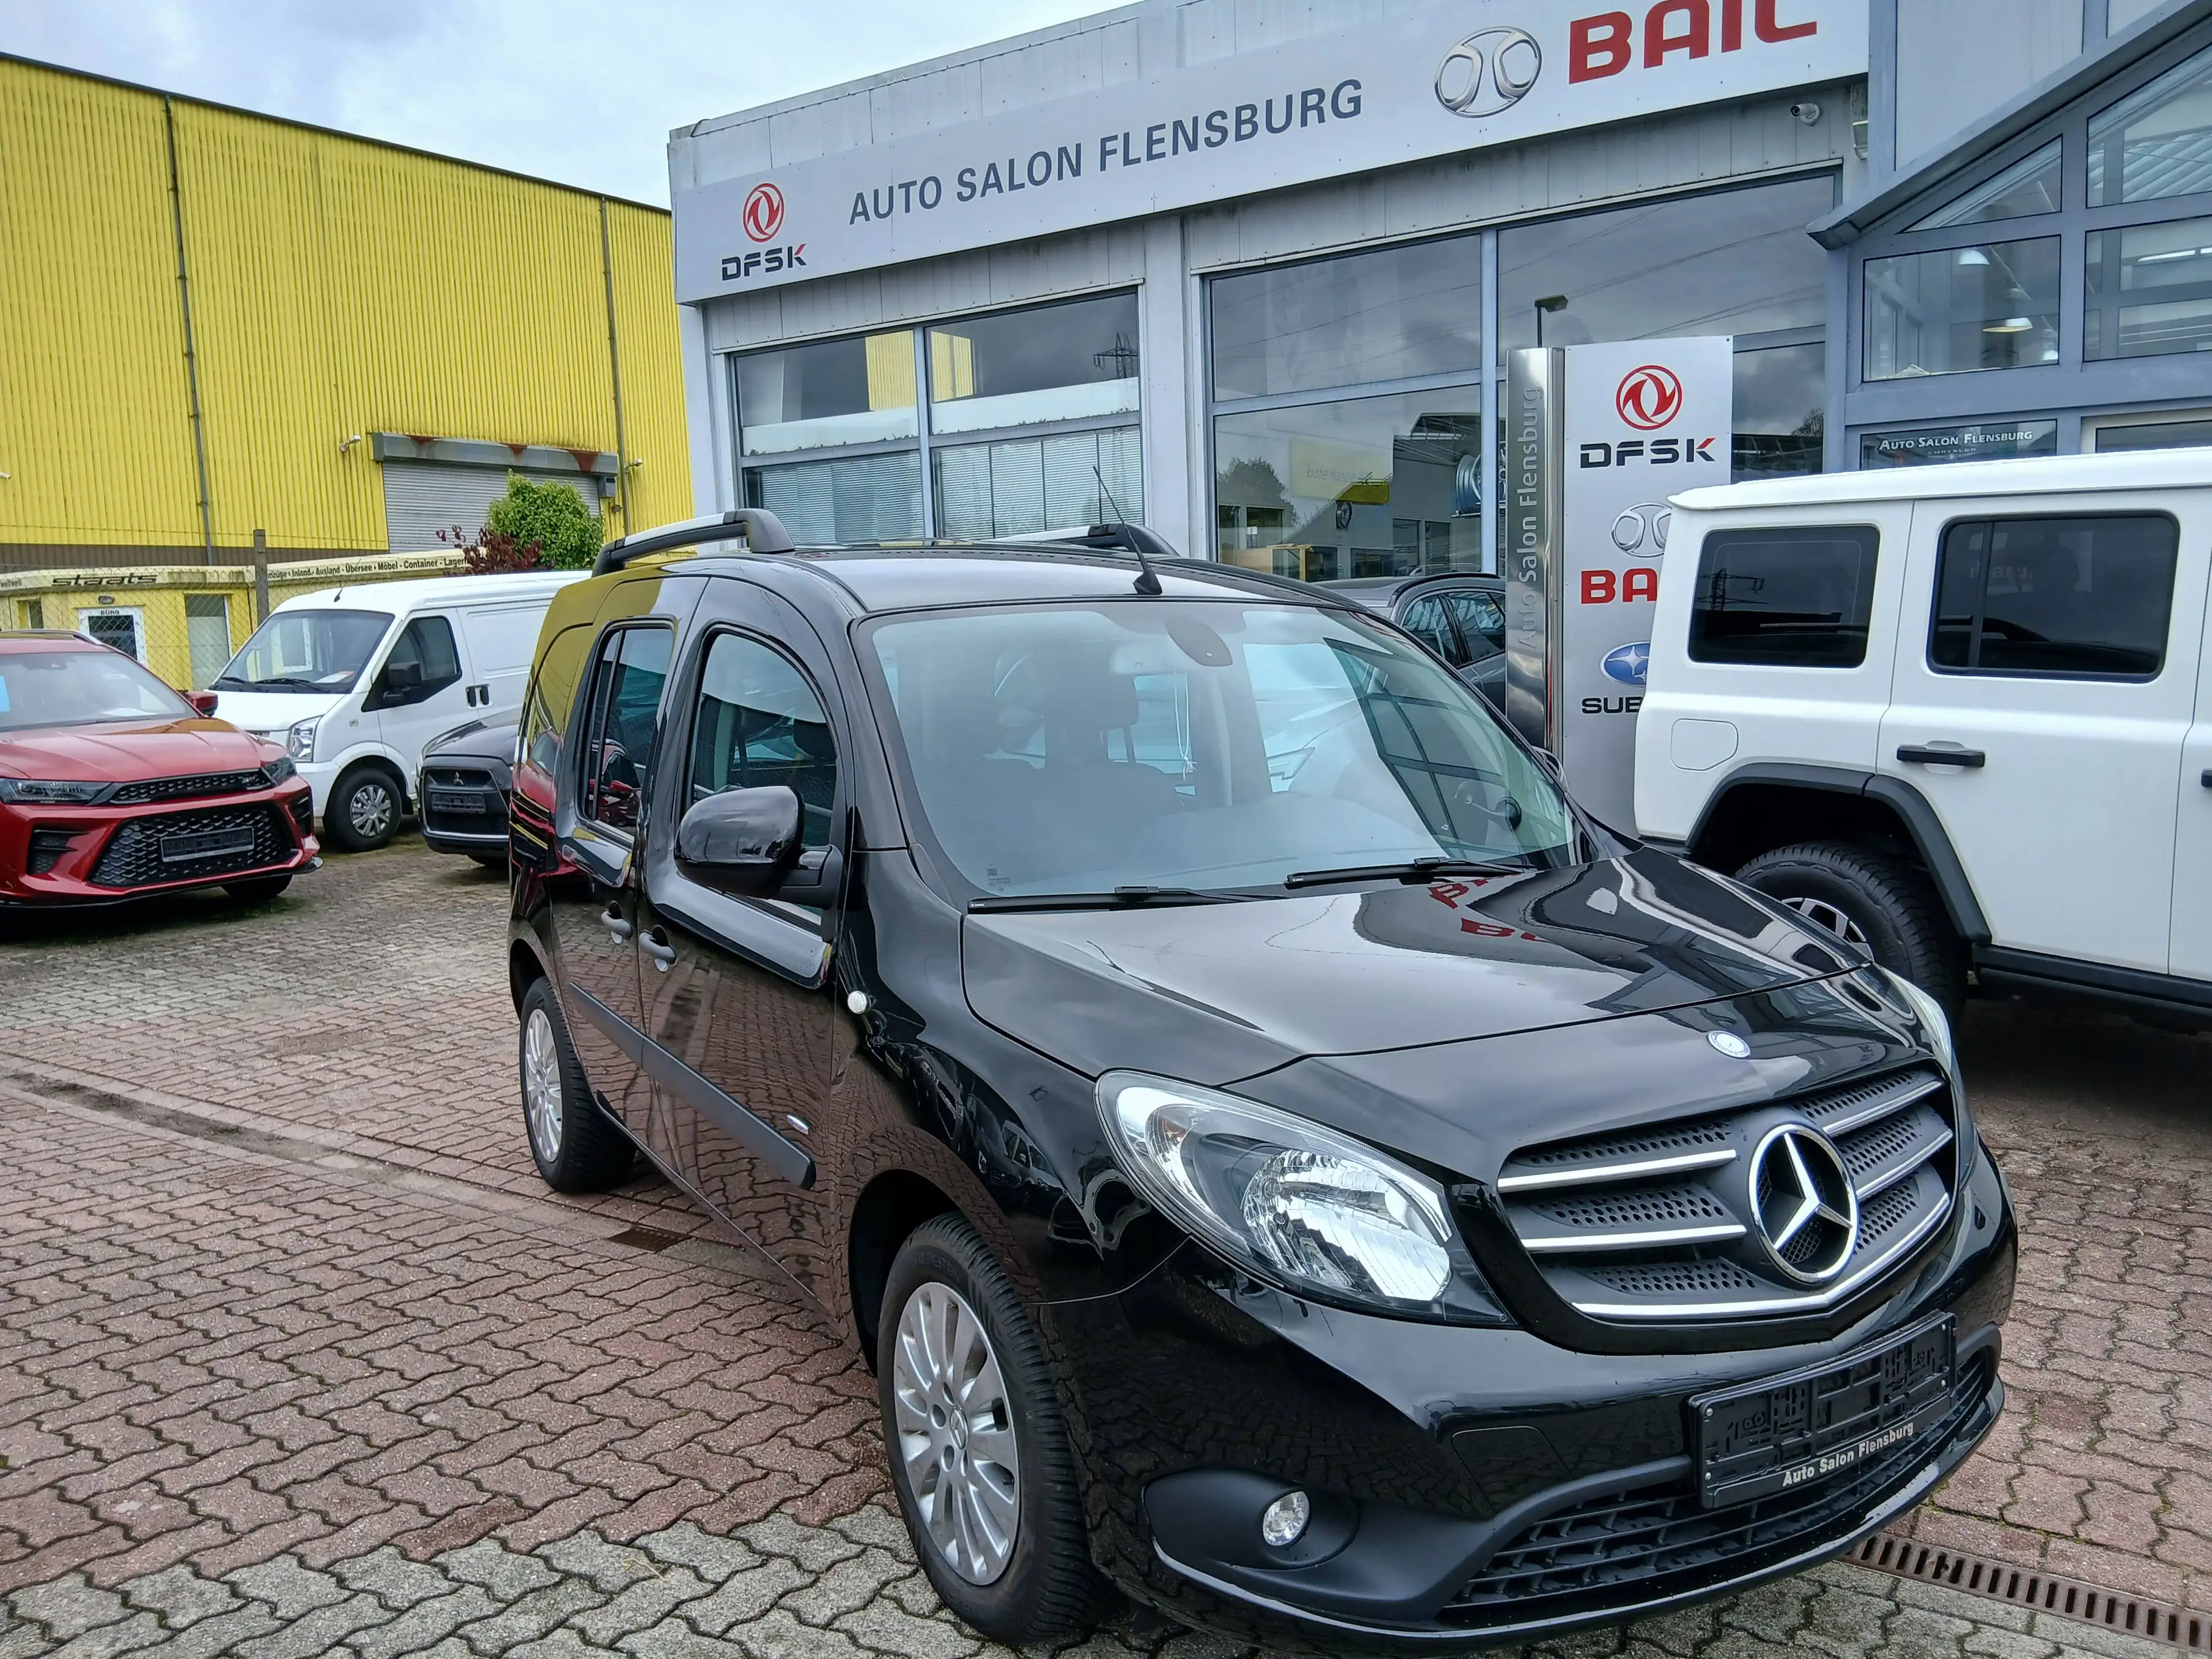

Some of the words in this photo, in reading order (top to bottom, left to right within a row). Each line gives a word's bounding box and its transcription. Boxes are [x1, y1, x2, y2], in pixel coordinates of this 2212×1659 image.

[849, 176, 942, 226] AUTO
[955, 143, 1083, 202] SALON
[1099, 78, 1363, 172] FLENSBURG
[722, 243, 807, 281] DFSK
[1516, 386, 1544, 507] Flensburg
[1580, 437, 1716, 468] DFSK
[316, 566, 340, 575] Ausland
[346, 563, 372, 573] Übersee
[378, 561, 398, 570] Möbel
[404, 559, 438, 569] Container
[1516, 517, 1537, 584] Salon
[1581, 568, 1658, 604] BA
[1517, 592, 1537, 649] Auto
[1582, 696, 1644, 714] SUB
[1782, 1466, 1815, 1487] Auto
[1819, 1450, 1854, 1473] Salon
[1858, 1422, 1914, 1458] Flensburg
